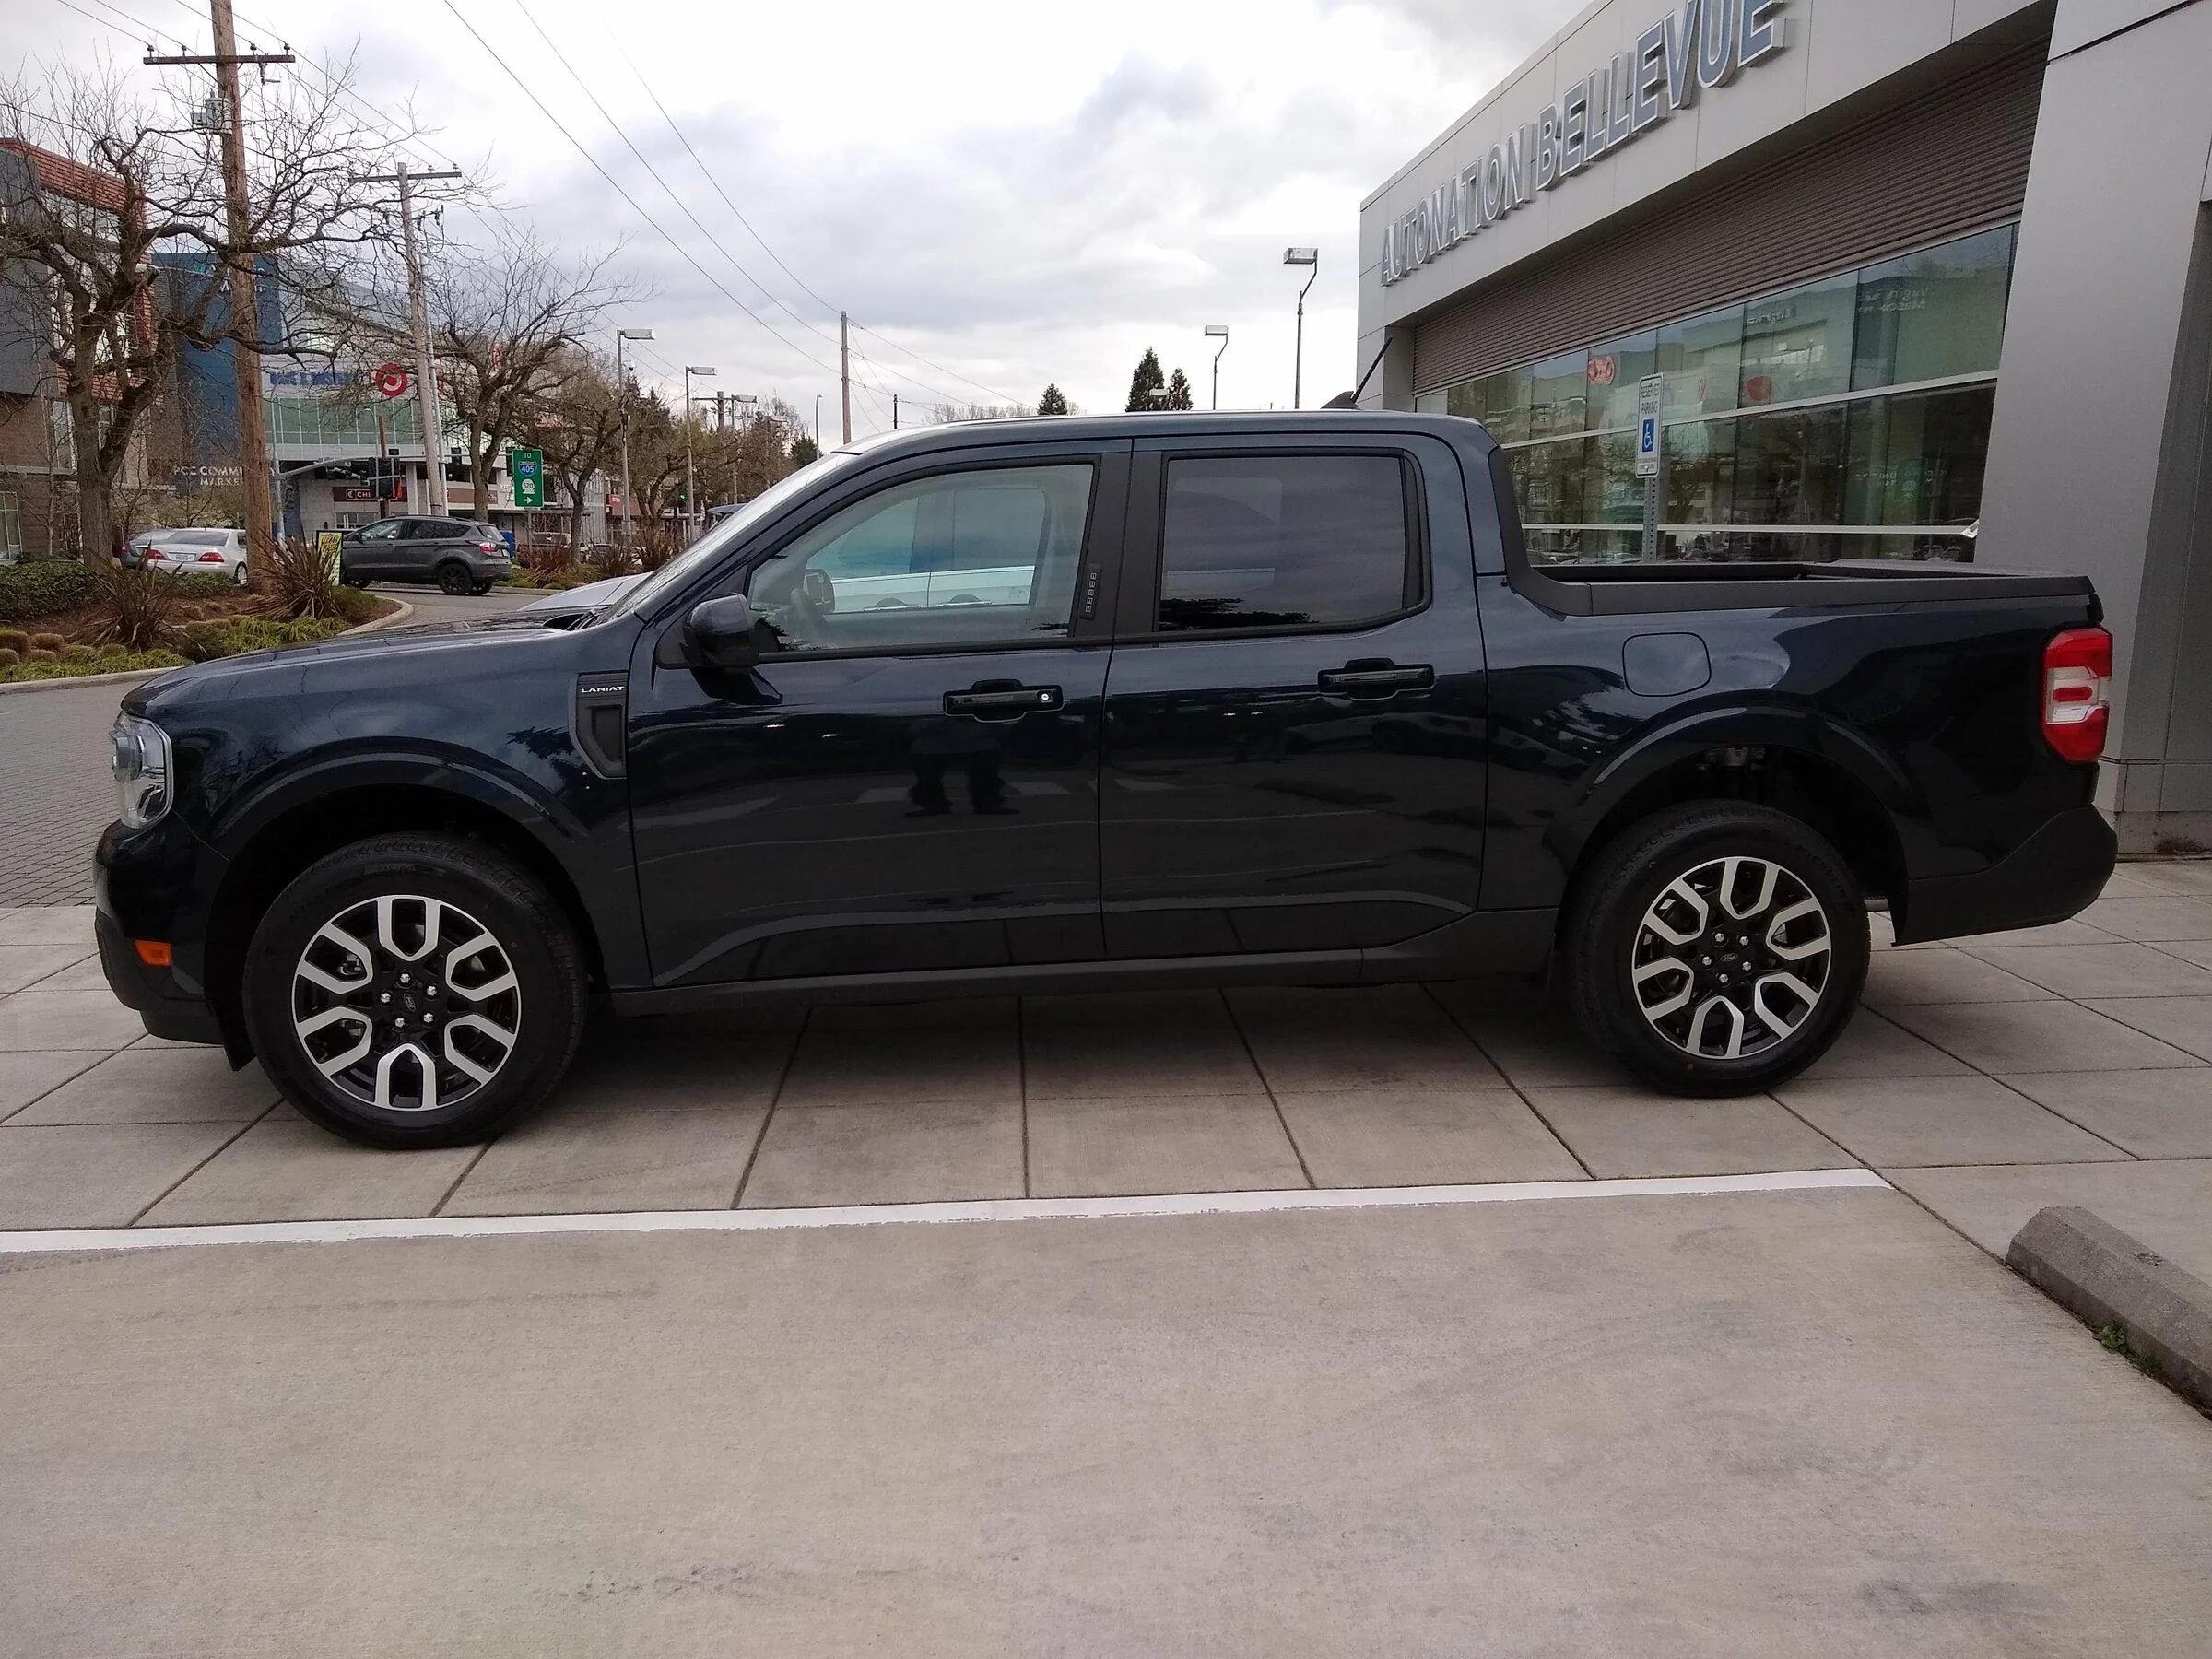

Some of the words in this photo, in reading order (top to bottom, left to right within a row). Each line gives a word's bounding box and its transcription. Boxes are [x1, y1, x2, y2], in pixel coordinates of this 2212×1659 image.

[1380, 124, 1531, 287] AUTONATION
[1536, 0, 1779, 192] BELLEVUE
[1641, 382, 1660, 398] RESERVED
[1641, 400, 1658, 415] PARKING
[521, 465, 535, 473] 405
[200, 477, 244, 486] MARKE
